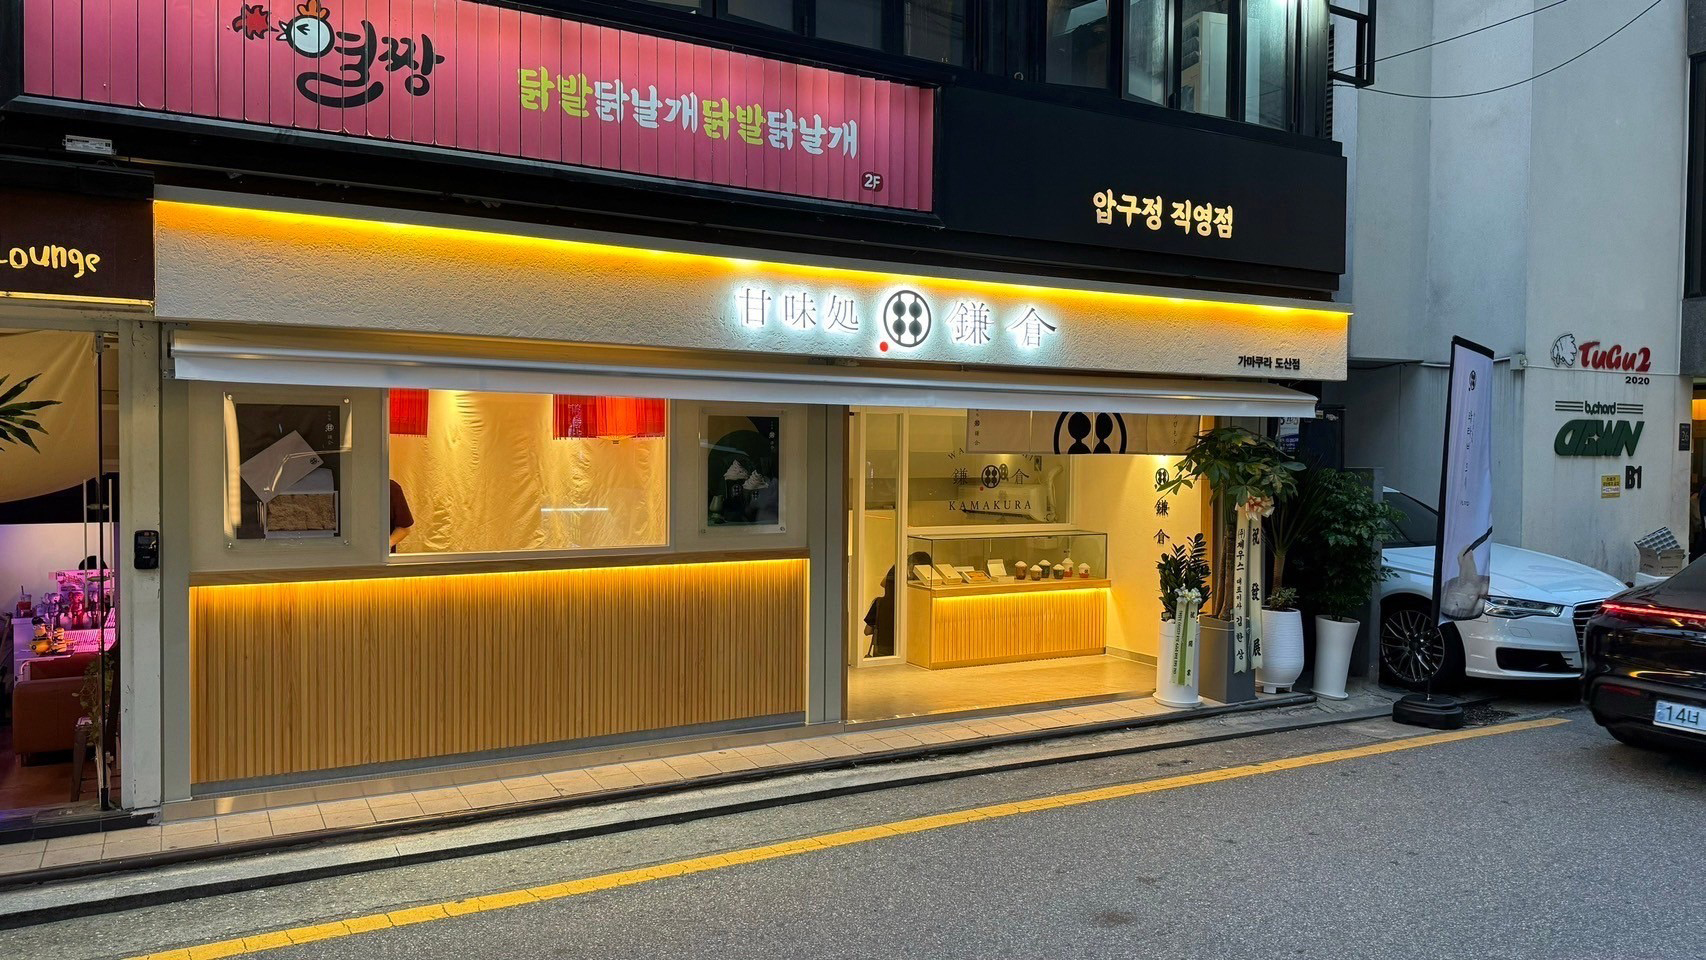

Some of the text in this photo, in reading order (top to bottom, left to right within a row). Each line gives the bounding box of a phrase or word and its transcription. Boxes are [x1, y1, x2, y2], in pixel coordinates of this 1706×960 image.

[864, 173, 881, 190] 2F
[1093, 188, 1233, 239] 압구정 직영점
[738, 287, 1057, 347] 甘味処 鎌倉
[1238, 355, 1300, 371] 가마쿠라 도산점
[1625, 376, 1650, 385] 2020
[1625, 465, 1642, 489] B1
[949, 500, 1032, 511] KAMAKURA
